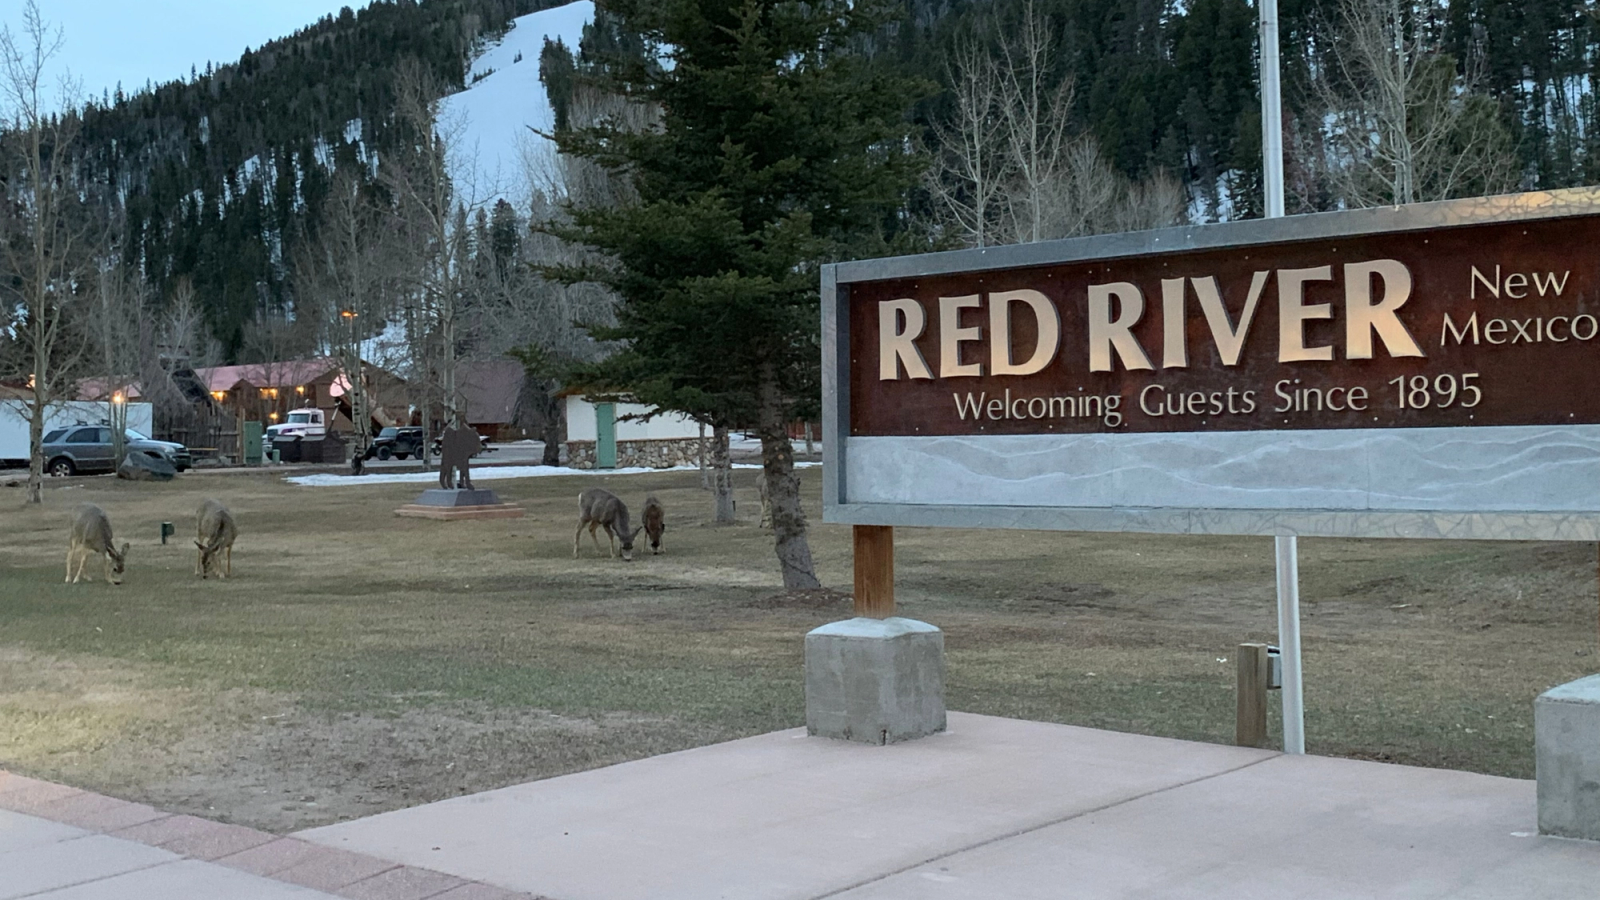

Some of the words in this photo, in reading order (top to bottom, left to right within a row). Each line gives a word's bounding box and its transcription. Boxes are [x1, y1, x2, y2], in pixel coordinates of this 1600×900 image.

[1471, 264, 1570, 299] New
[879, 288, 1061, 380] RED
[1088, 259, 1426, 373] RIVER
[1441, 311, 1599, 346] Mexico
[953, 388, 1122, 427] Welcoming
[1140, 384, 1256, 416] Guests
[1275, 379, 1369, 413] Since
[1388, 372, 1482, 409] 1895
